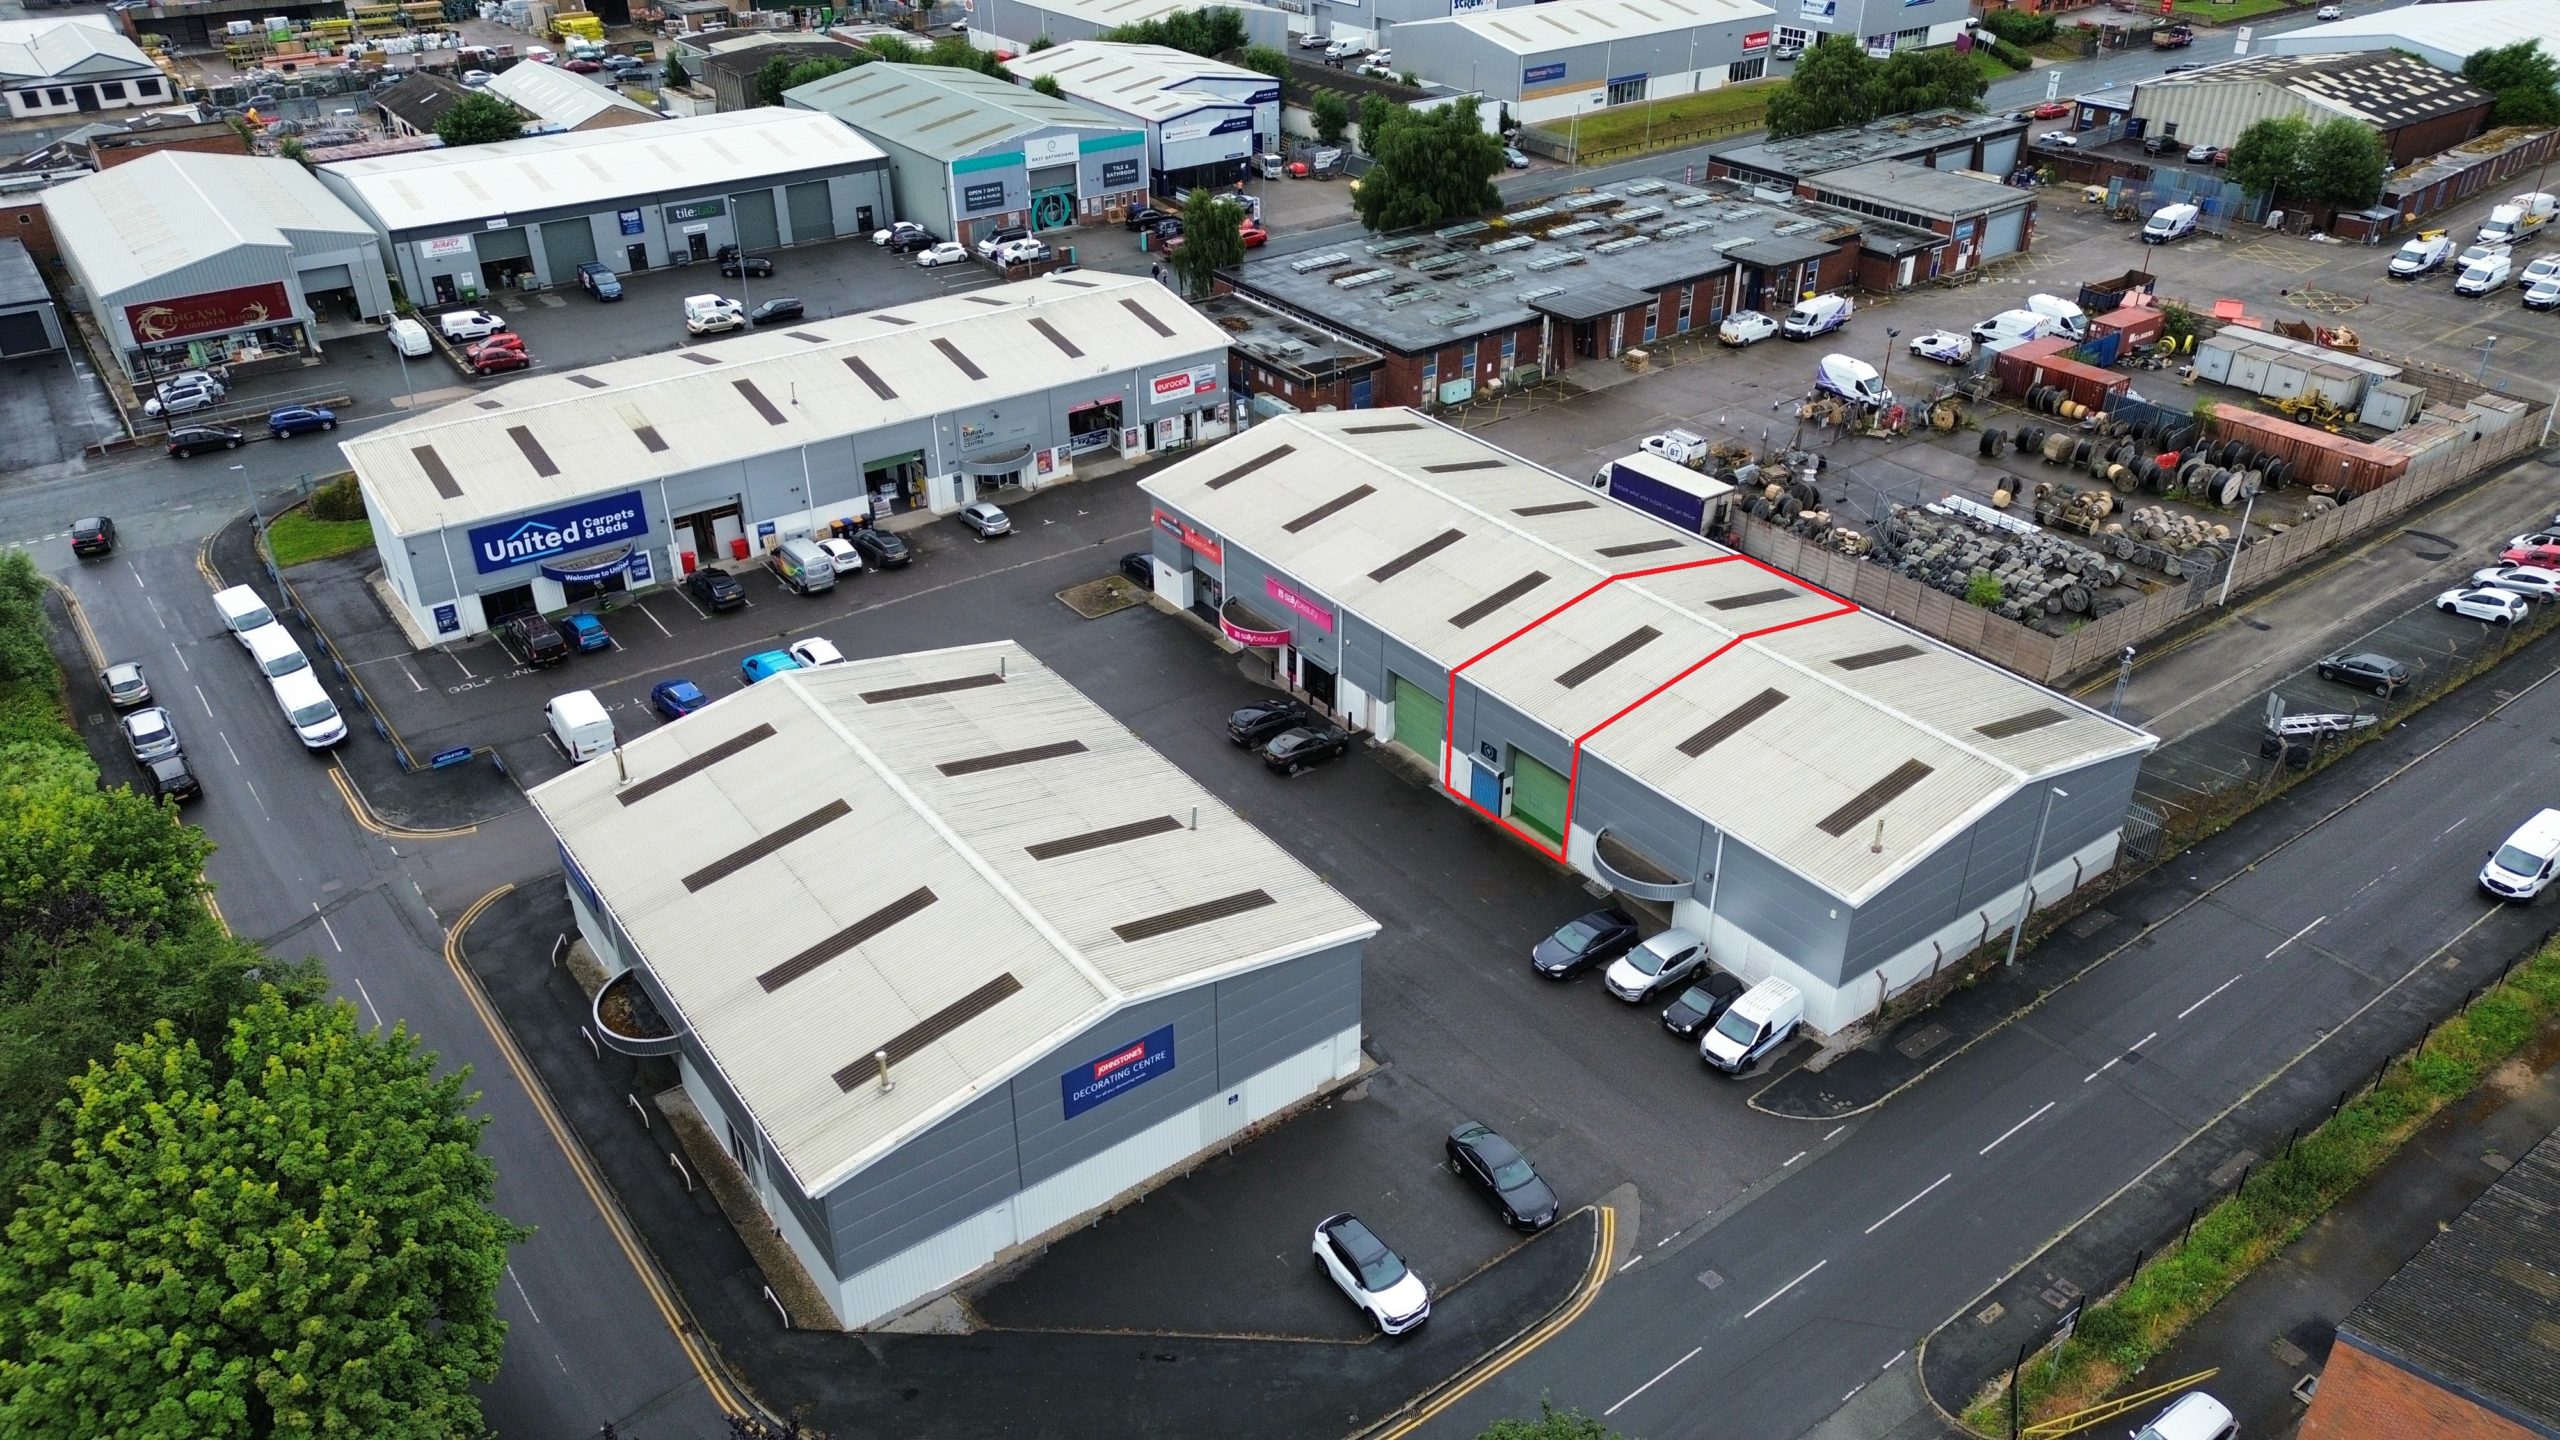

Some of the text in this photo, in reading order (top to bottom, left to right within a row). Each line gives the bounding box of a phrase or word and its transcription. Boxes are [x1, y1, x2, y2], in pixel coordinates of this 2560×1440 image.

[1106, 168, 1136, 178] BATHROOM
[968, 188, 982, 197] OPEN
[987, 186, 1001, 194] DAYS
[160, 307, 226, 326] ZING ASIA
[183, 317, 227, 330] ORIENTAL
[1157, 375, 1188, 392] eurocell
[962, 428, 983, 438] Dulux
[963, 432, 994, 443] DECORATOR
[964, 439, 985, 448] CENTRE
[1669, 448, 1680, 458] BT
[484, 509, 635, 562] United Carpets
[585, 520, 629, 538] & Beds
[565, 571, 600, 582] Welcome
[609, 560, 630, 575] United
[448, 675, 496, 694] GOLF
[1073, 1050, 1167, 1101] DECORATING CENTRE
